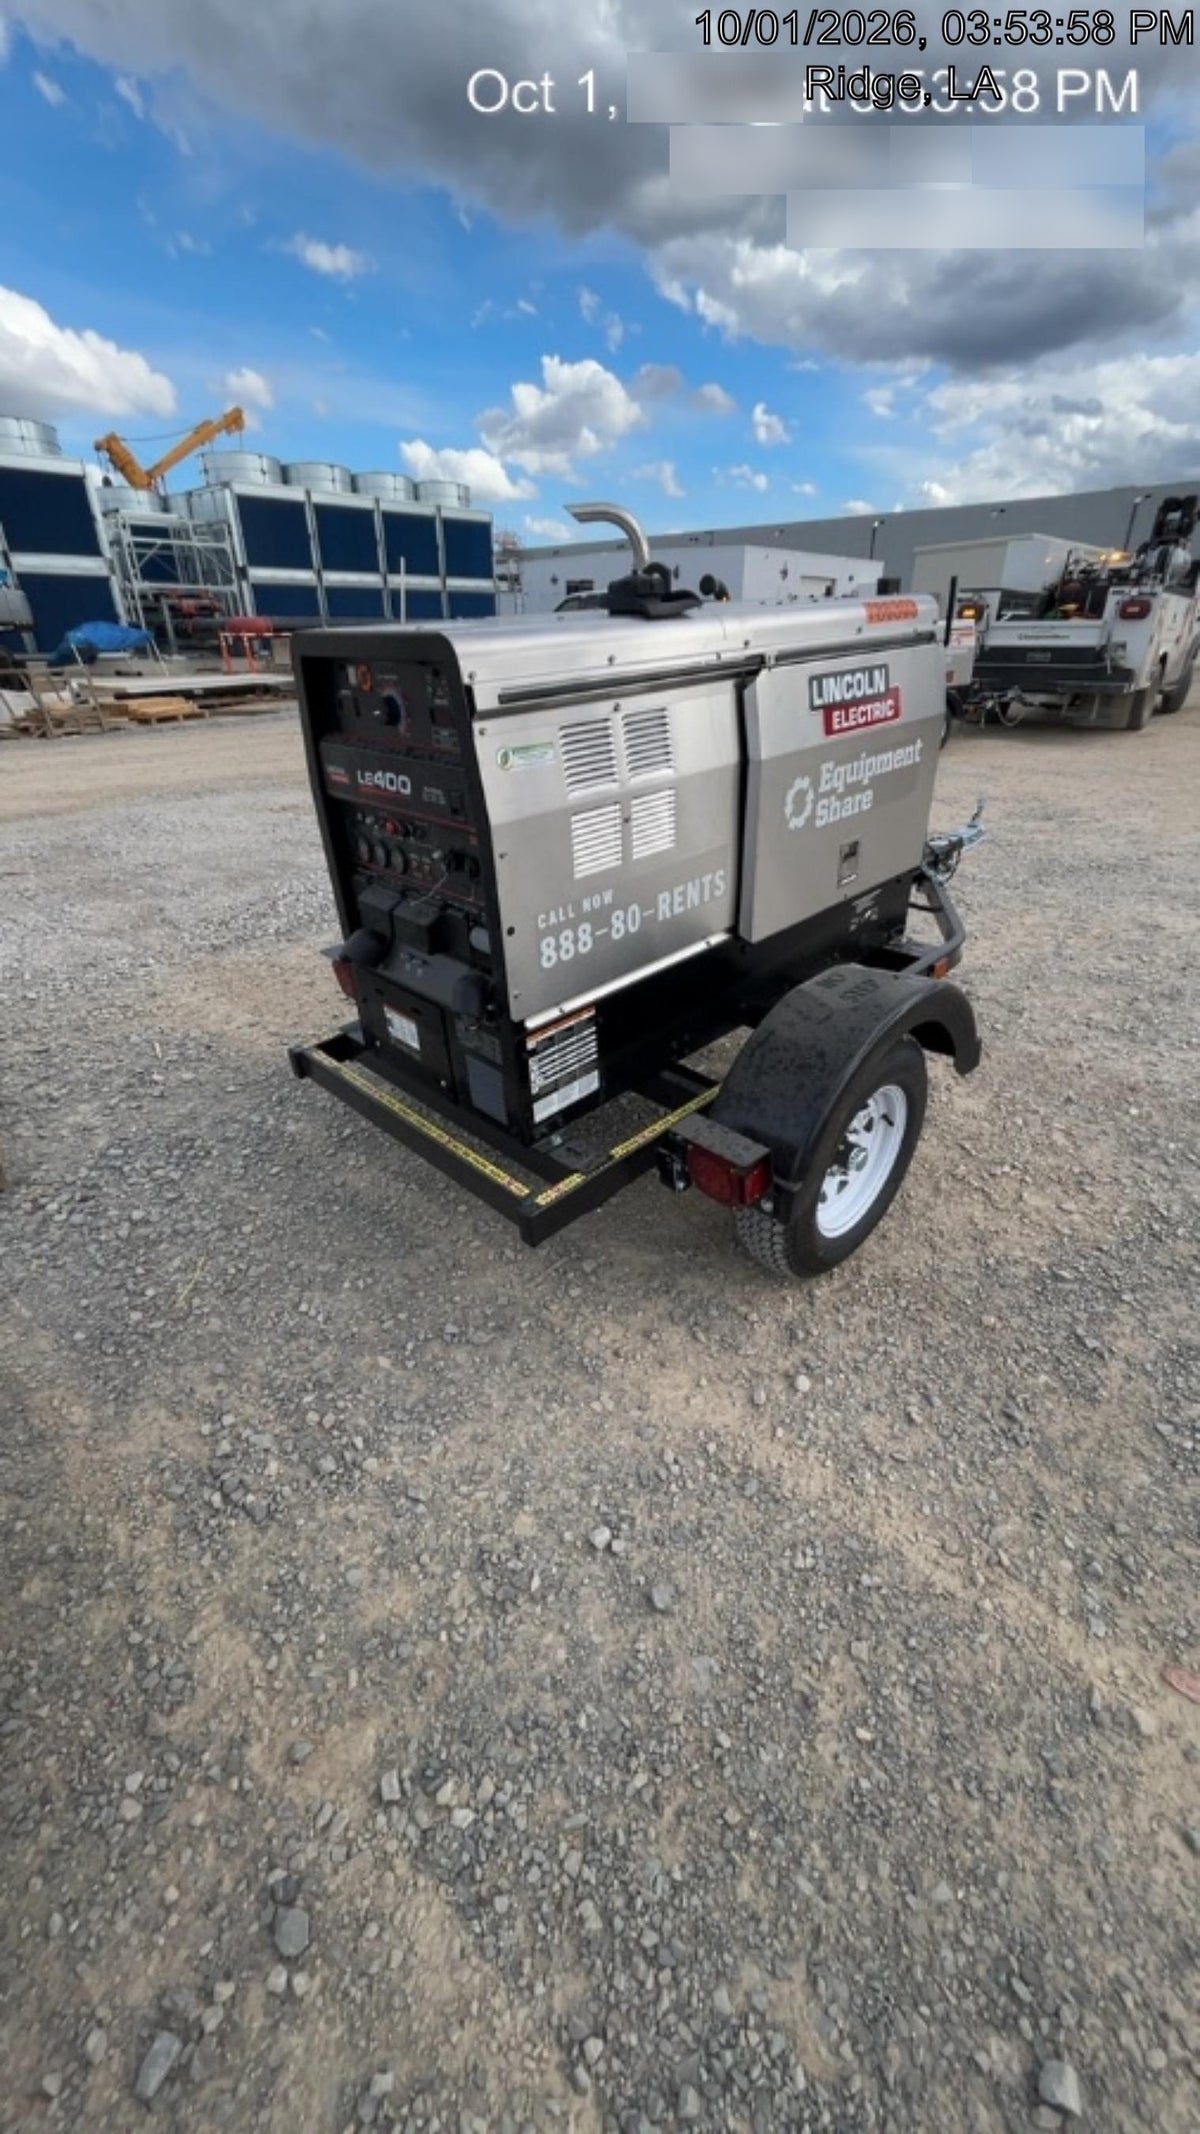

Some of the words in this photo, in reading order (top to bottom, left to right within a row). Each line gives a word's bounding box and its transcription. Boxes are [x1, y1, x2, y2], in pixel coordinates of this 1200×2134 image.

[813, 668, 886, 706] LINCOLN
[832, 699, 895, 731] ELECTRIC
[818, 738, 924, 793] Equipment
[815, 789, 874, 829] Share
[537, 904, 576, 929] CALL
[582, 889, 614, 912] NOW
[540, 869, 726, 969] 888-80-RENTS
